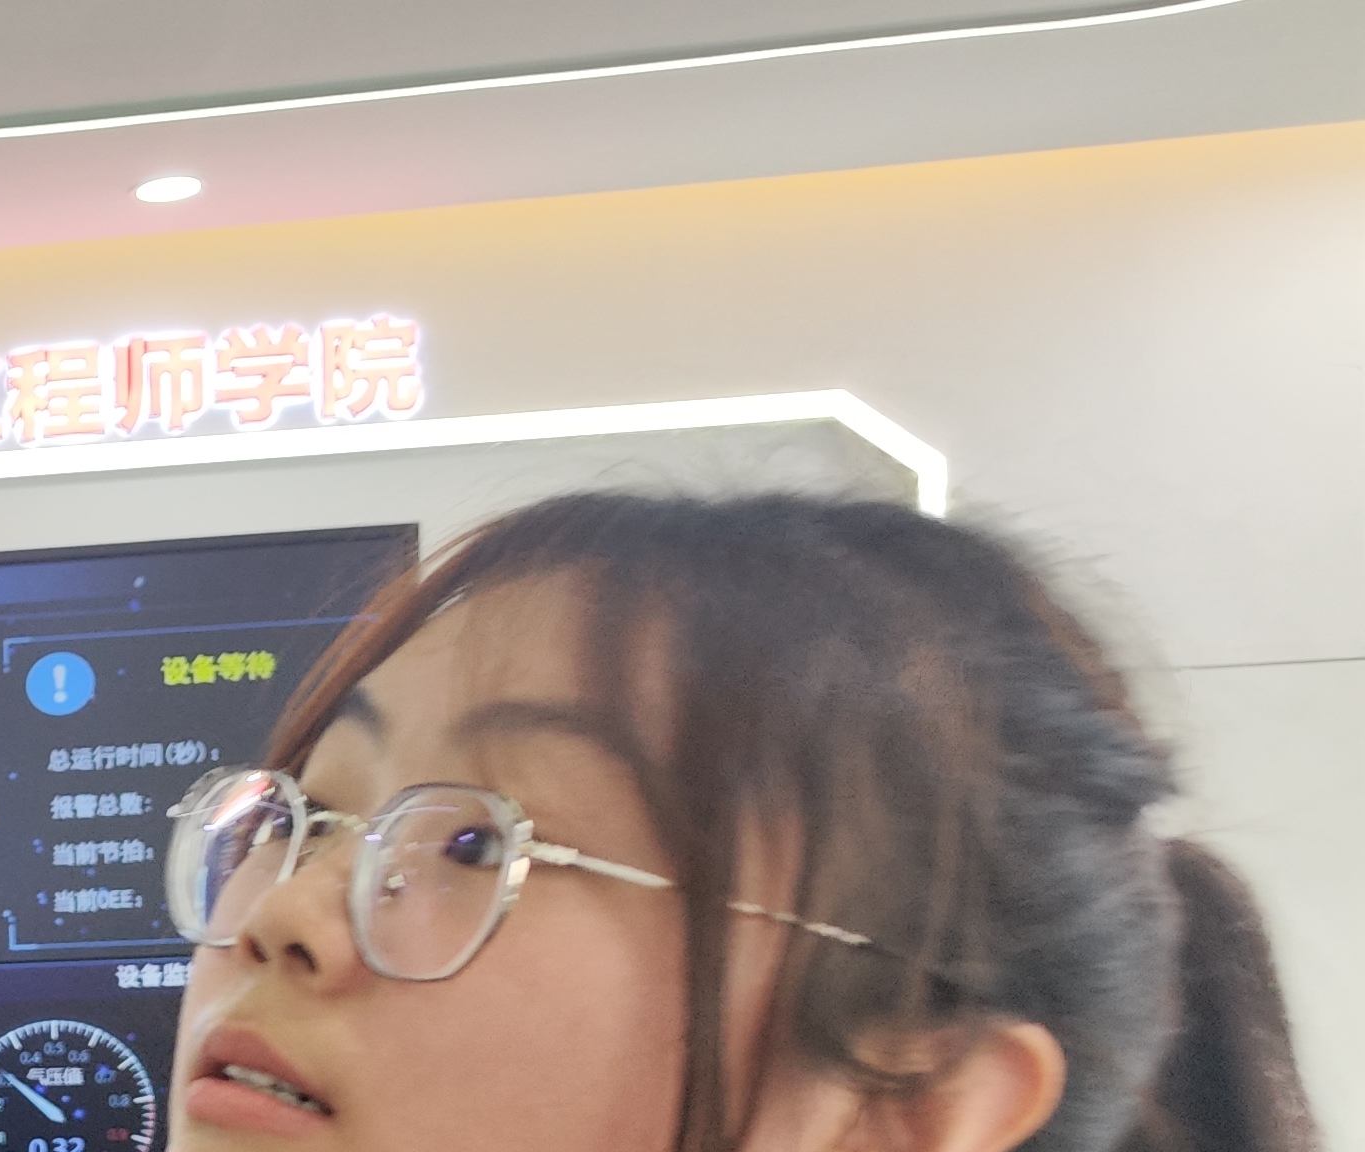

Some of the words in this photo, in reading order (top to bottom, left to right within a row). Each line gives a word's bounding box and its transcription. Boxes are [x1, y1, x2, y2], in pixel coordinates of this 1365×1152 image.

[161, 651, 276, 686] 设备等待
[115, 963, 193, 989] 设备监
